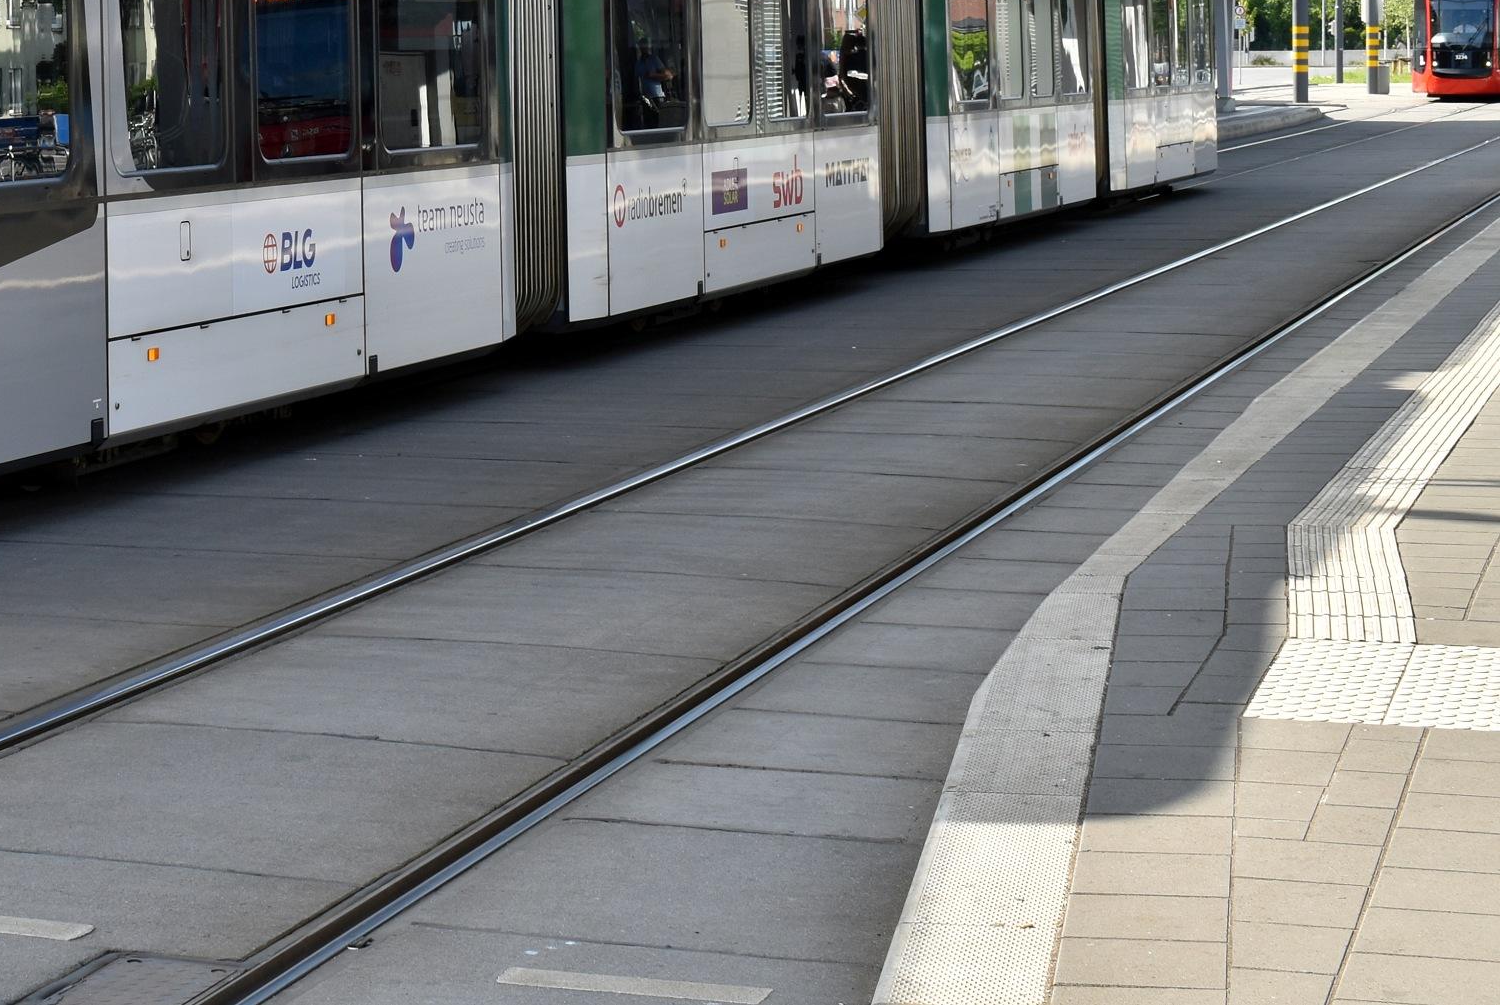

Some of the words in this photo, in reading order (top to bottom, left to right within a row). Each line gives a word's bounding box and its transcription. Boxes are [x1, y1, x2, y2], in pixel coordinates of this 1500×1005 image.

[772, 154, 803, 209] swb
[417, 204, 446, 233] team
[449, 197, 485, 228] neusta
[627, 185, 683, 221] radiobremen
[280, 228, 316, 272] BLG
[291, 272, 321, 289] LOGISTICS
